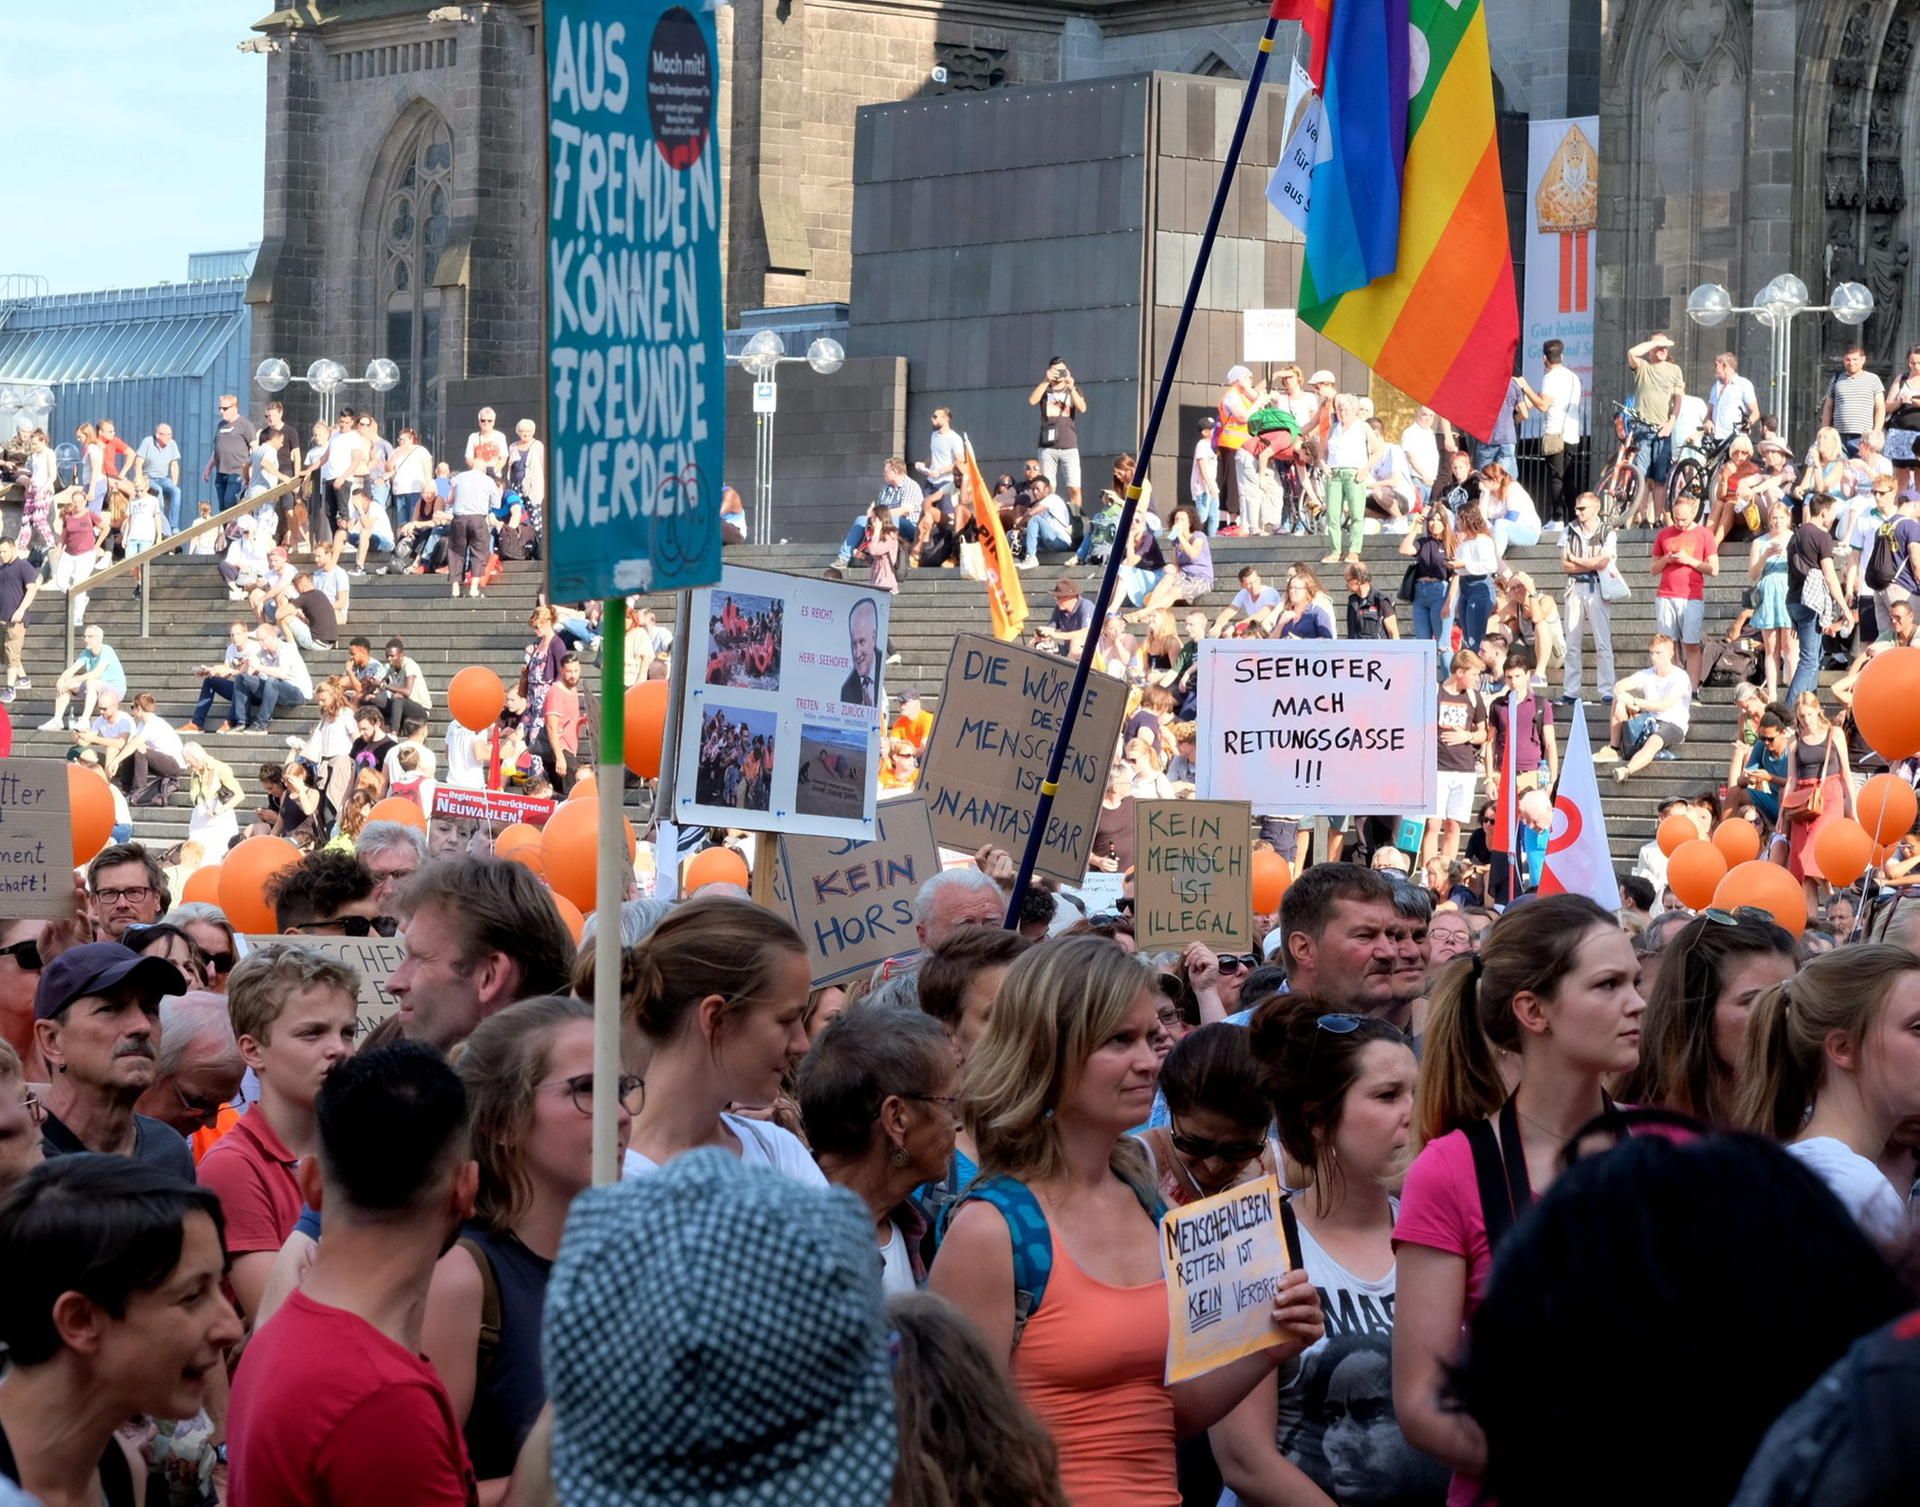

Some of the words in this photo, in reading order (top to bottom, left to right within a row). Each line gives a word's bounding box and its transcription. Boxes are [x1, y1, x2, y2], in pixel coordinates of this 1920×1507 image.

[553, 15, 629, 114] AUS
[652, 50, 682, 74] Mach
[684, 53, 706, 76] mit!
[1294, 147, 1309, 171] für
[551, 119, 715, 249] FREMDEN
[1283, 181, 1304, 206] aus
[551, 235, 699, 343] KÖNNEN
[551, 342, 708, 442] FREUNDE
[556, 438, 699, 532] WERDEN
[801, 605, 809, 617] ES
[799, 652, 816, 664] HERR
[1234, 656, 1391, 691] SEEHOFER,
[963, 650, 1010, 687] DIE
[1022, 666, 1098, 718] WÜRE
[796, 698, 819, 711] TRETEN
[826, 702, 836, 714] SIE
[1271, 692, 1344, 717] MACH
[1224, 727, 1405, 755] RETTUNGSGASSE
[1295, 758, 1322, 788] !!!
[498, 799, 549, 813] zurücktreten!
[925, 781, 1082, 861] UNANTASBAR
[1149, 809, 1220, 841] KEIN
[1147, 843, 1242, 878] MENSCH
[812, 854, 917, 905] KEIN
[1180, 879, 1212, 905] IST
[814, 899, 913, 957] HORS
[1149, 910, 1238, 936] ILLEGAL
[1165, 1187, 1273, 1260] MENSCHENLEBEN
[1176, 1247, 1225, 1288] RETTEN
[1237, 1238, 1254, 1267] IST
[1188, 1283, 1222, 1319] KEIN
[1232, 1271, 1287, 1313] VERBRE
